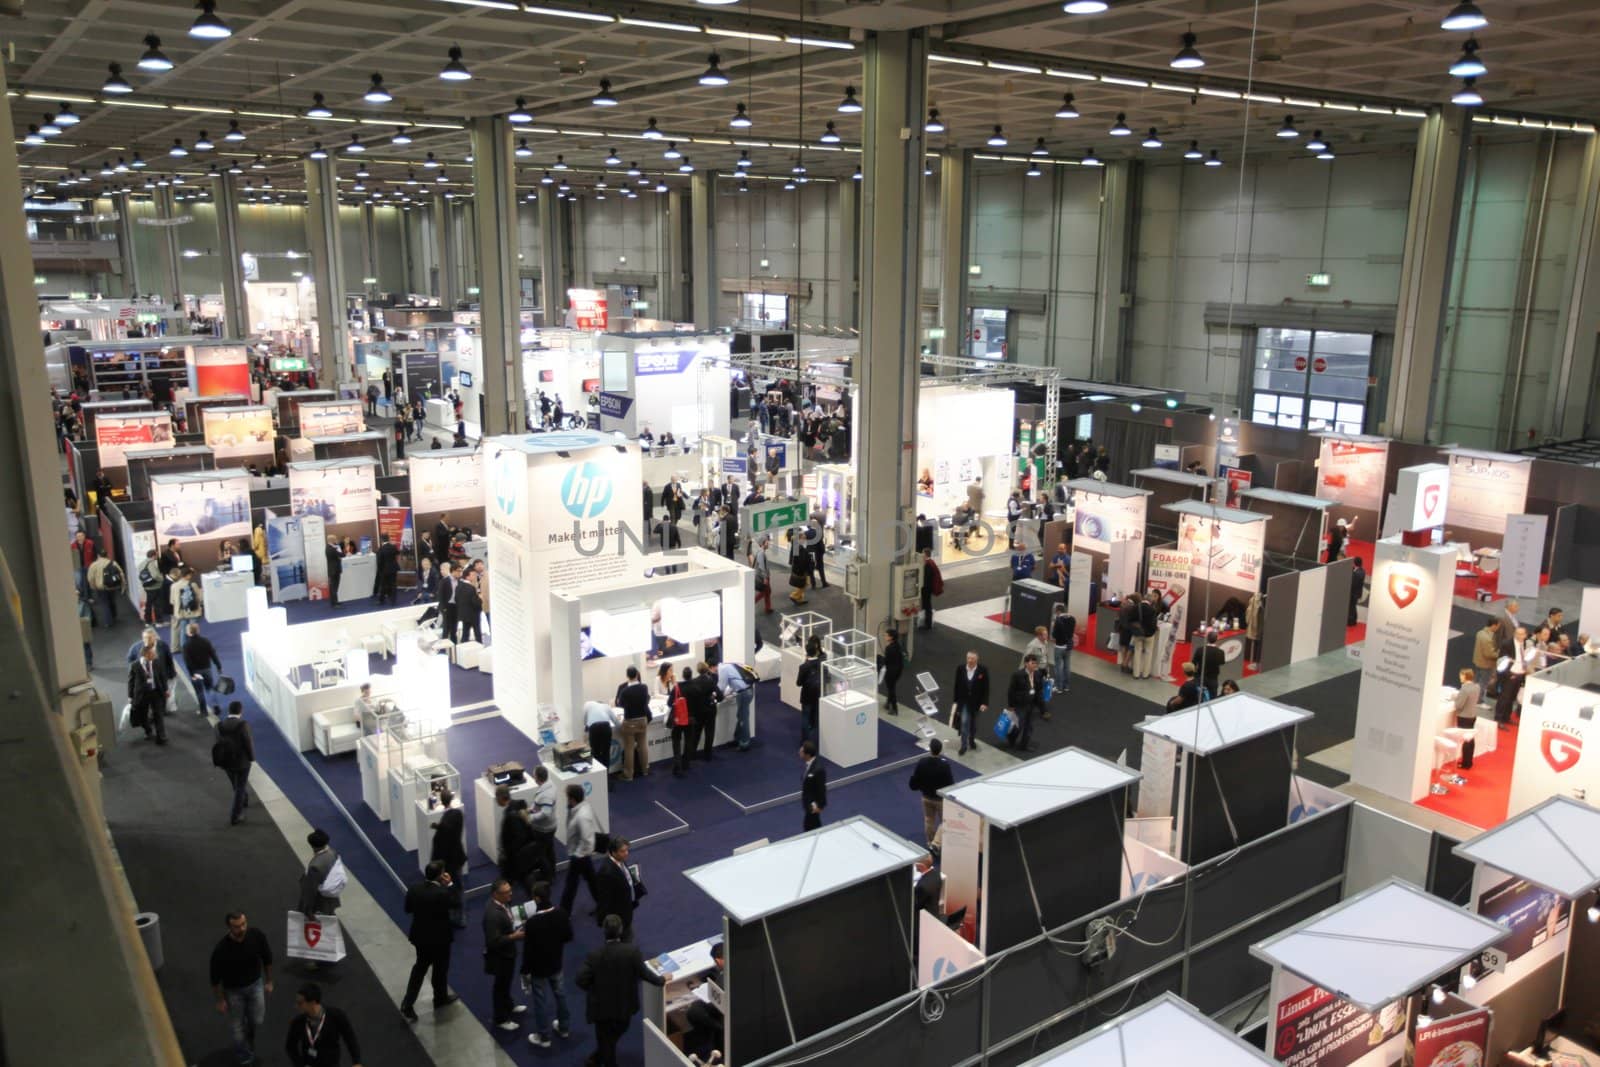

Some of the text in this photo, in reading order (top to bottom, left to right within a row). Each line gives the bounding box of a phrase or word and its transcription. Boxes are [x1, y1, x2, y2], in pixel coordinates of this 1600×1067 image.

[637, 354, 680, 368] EPSON
[600, 394, 621, 411] EPSON
[564, 461, 611, 519] hp
[548, 531, 574, 544] Make
[589, 526, 624, 538] matter
[1153, 553, 1189, 564] FDA600
[1280, 998, 1311, 1020] Linux
